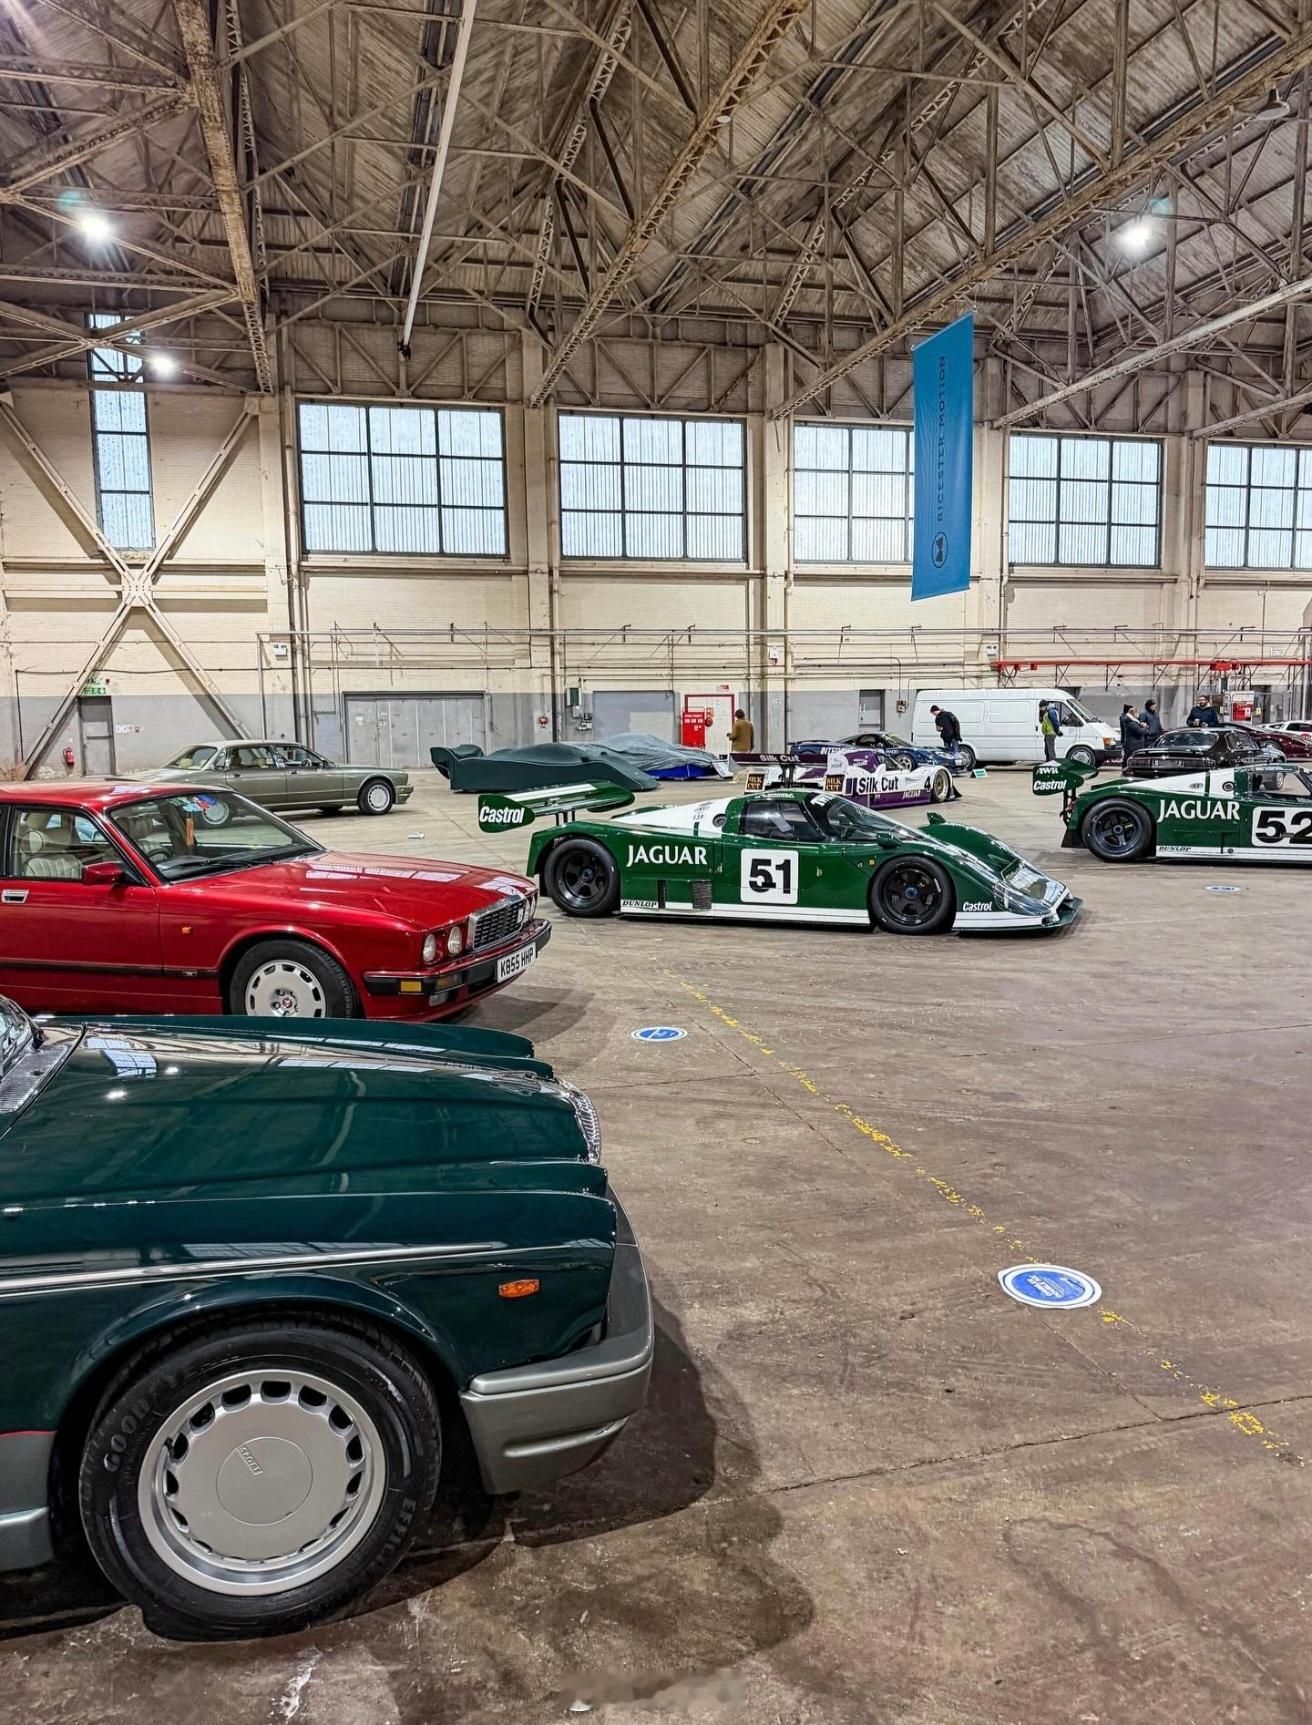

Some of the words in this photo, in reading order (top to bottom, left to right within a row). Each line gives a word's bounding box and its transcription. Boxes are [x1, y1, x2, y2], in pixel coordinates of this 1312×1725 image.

[938, 356, 946, 427] MOTION
[937, 435, 945, 522] BICESTER
[760, 754, 778, 762] Silk
[780, 754, 800, 762] Cut
[858, 776, 878, 794] Silk
[881, 776, 899, 791] Cut
[923, 776, 932, 791] 4
[1033, 779, 1067, 791] Castrol
[479, 806, 525, 824] Castrol
[1157, 799, 1240, 823] JAGUAR
[1255, 810, 1312, 844] 52
[626, 845, 708, 868] JAGUAR
[748, 858, 792, 894] 51
[622, 900, 657, 908] DUNLOP
[962, 901, 993, 911] Castrol
